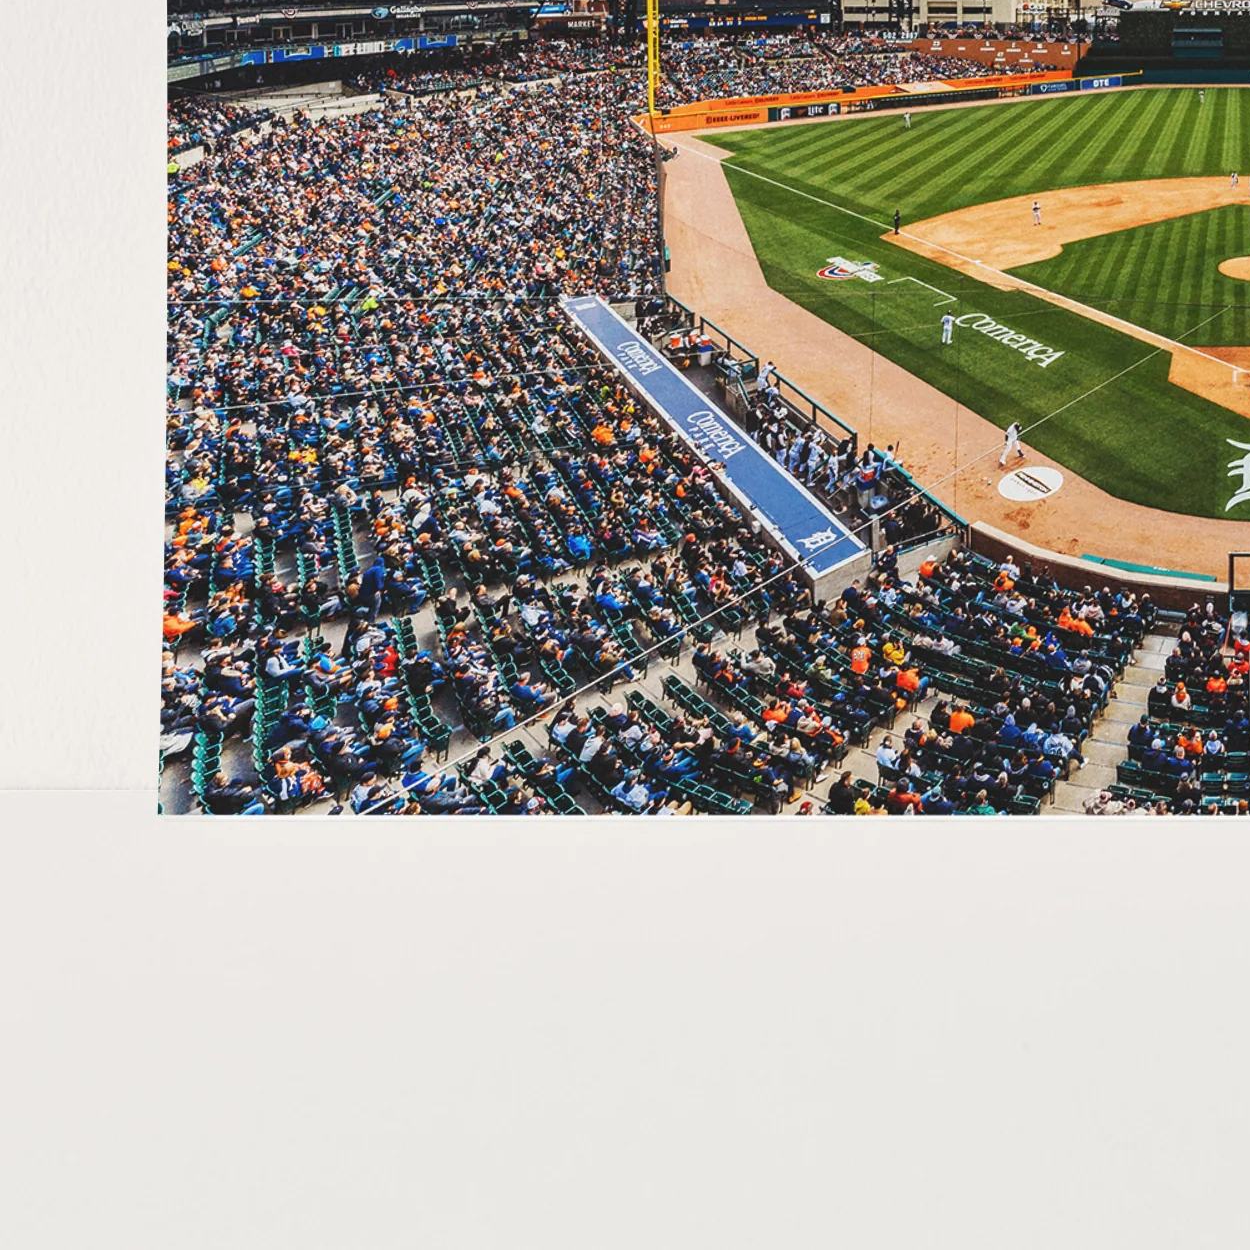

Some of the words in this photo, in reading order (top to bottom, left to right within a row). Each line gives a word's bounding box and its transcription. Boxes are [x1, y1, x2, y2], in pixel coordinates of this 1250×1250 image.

[567, 20, 596, 29] MARKET
[1092, 78, 1110, 88] DTE
[807, 105, 824, 116] Lite
